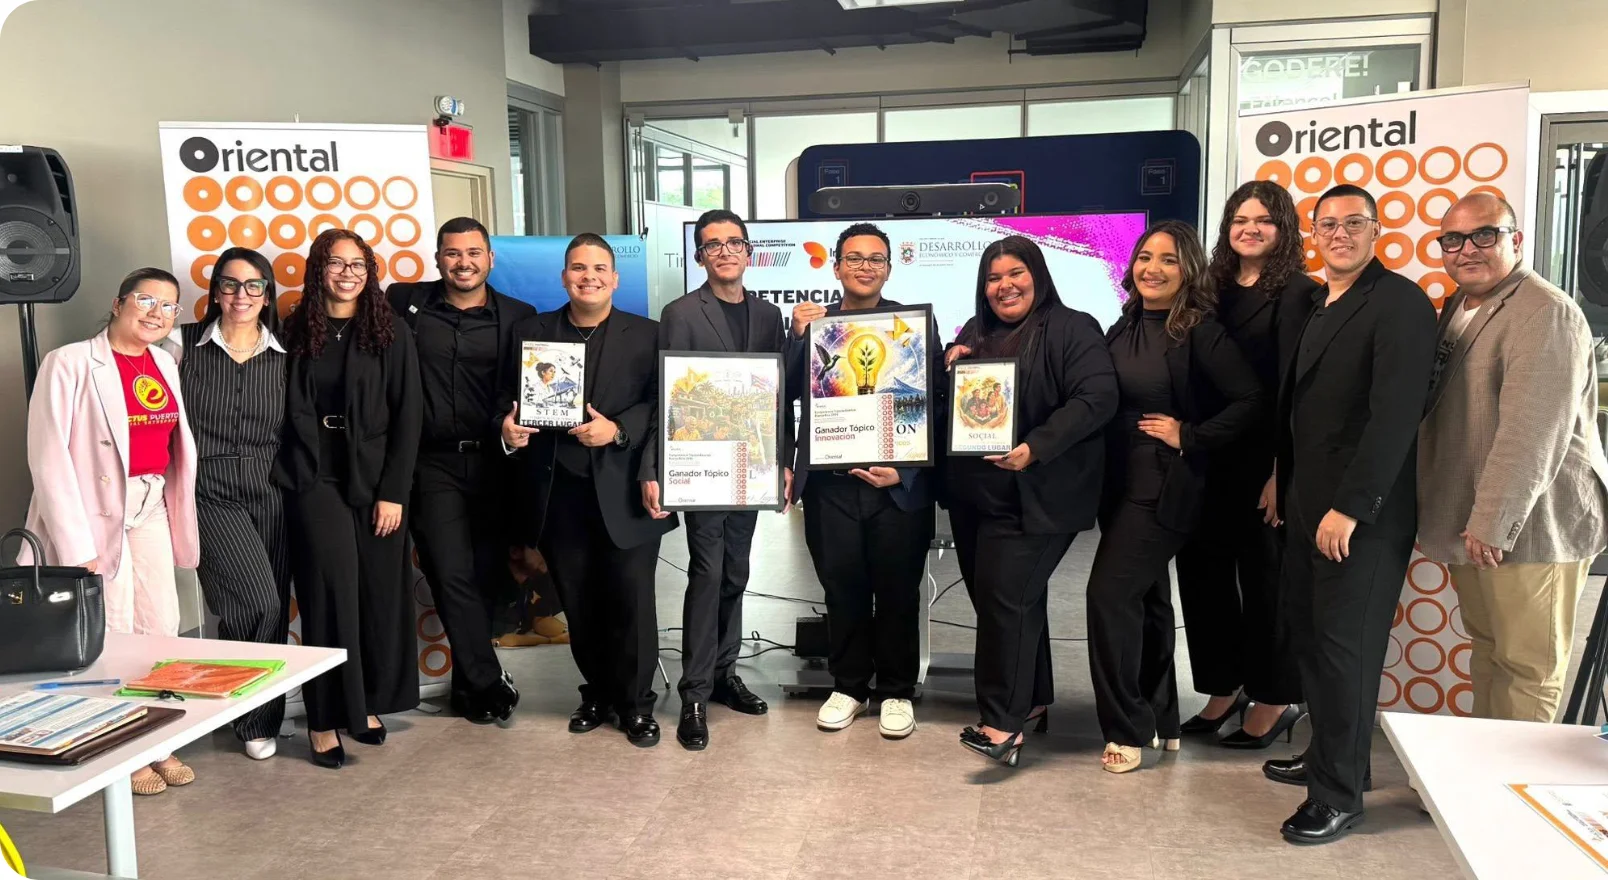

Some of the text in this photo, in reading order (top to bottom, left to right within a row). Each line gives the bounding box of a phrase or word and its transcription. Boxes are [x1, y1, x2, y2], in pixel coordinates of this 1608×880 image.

[1255, 110, 1417, 157] Oriental
[179, 136, 339, 173] Oriental
[612, 245, 641, 254] ROLLO
[150, 412, 179, 420] PUERTO
[536, 408, 569, 416] STEM
[521, 419, 554, 427] TERCER
[814, 423, 875, 434] Ganador Tópico
[814, 432, 856, 442] Innovación
[668, 469, 729, 479] Ganador Tópico
[668, 477, 691, 485] Social
